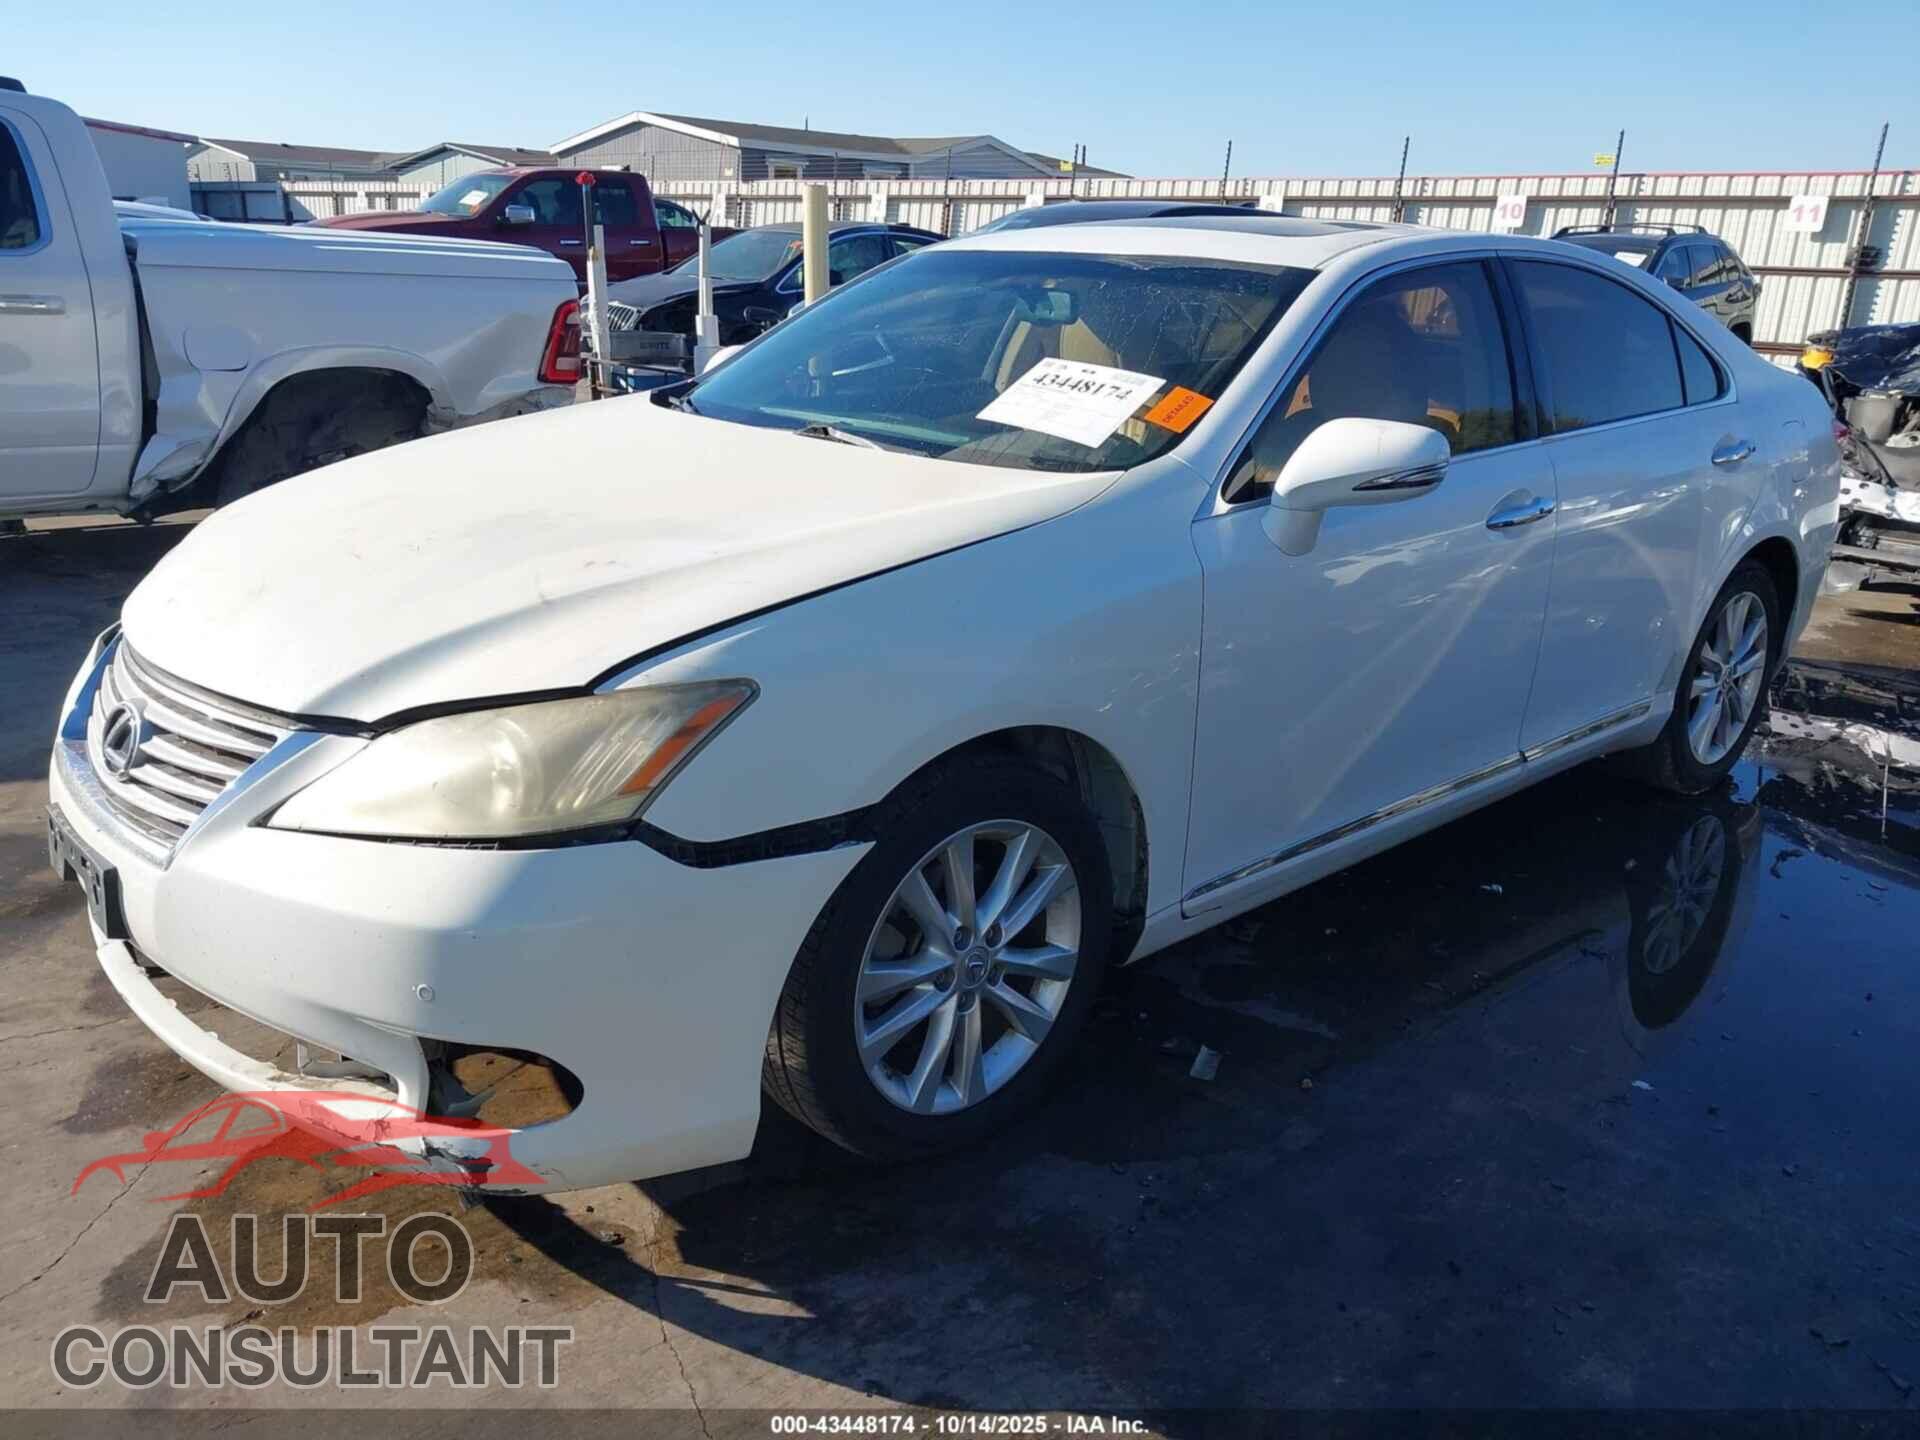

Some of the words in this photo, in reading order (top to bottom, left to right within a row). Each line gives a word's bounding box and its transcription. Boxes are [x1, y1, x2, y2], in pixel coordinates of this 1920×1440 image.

[1500, 203, 1523, 219] 10
[1792, 203, 1821, 223] 11
[1033, 373, 1133, 399] 43448174
